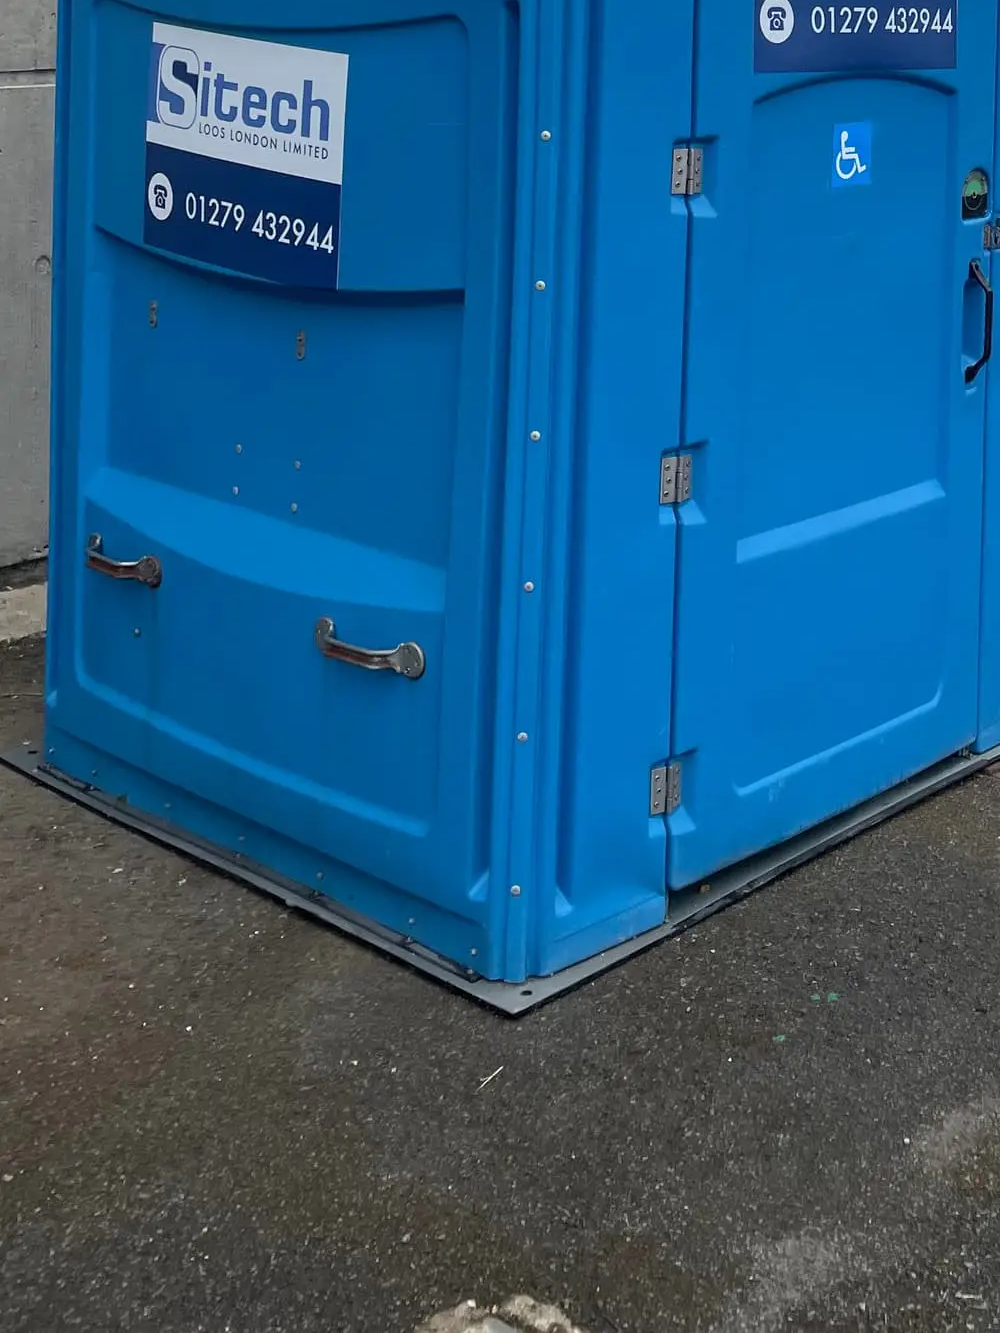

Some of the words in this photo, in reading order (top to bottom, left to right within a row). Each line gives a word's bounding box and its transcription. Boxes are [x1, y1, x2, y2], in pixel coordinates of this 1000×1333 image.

[811, 6, 879, 34] 01279
[884, 7, 953, 34] 432944
[157, 45, 330, 142] Sitech
[198, 123, 226, 140] LOOS
[230, 130, 278, 151] LONDON
[283, 140, 330, 161] LIMITED
[185, 192, 246, 232] 01279
[251, 209, 335, 255] 432944
